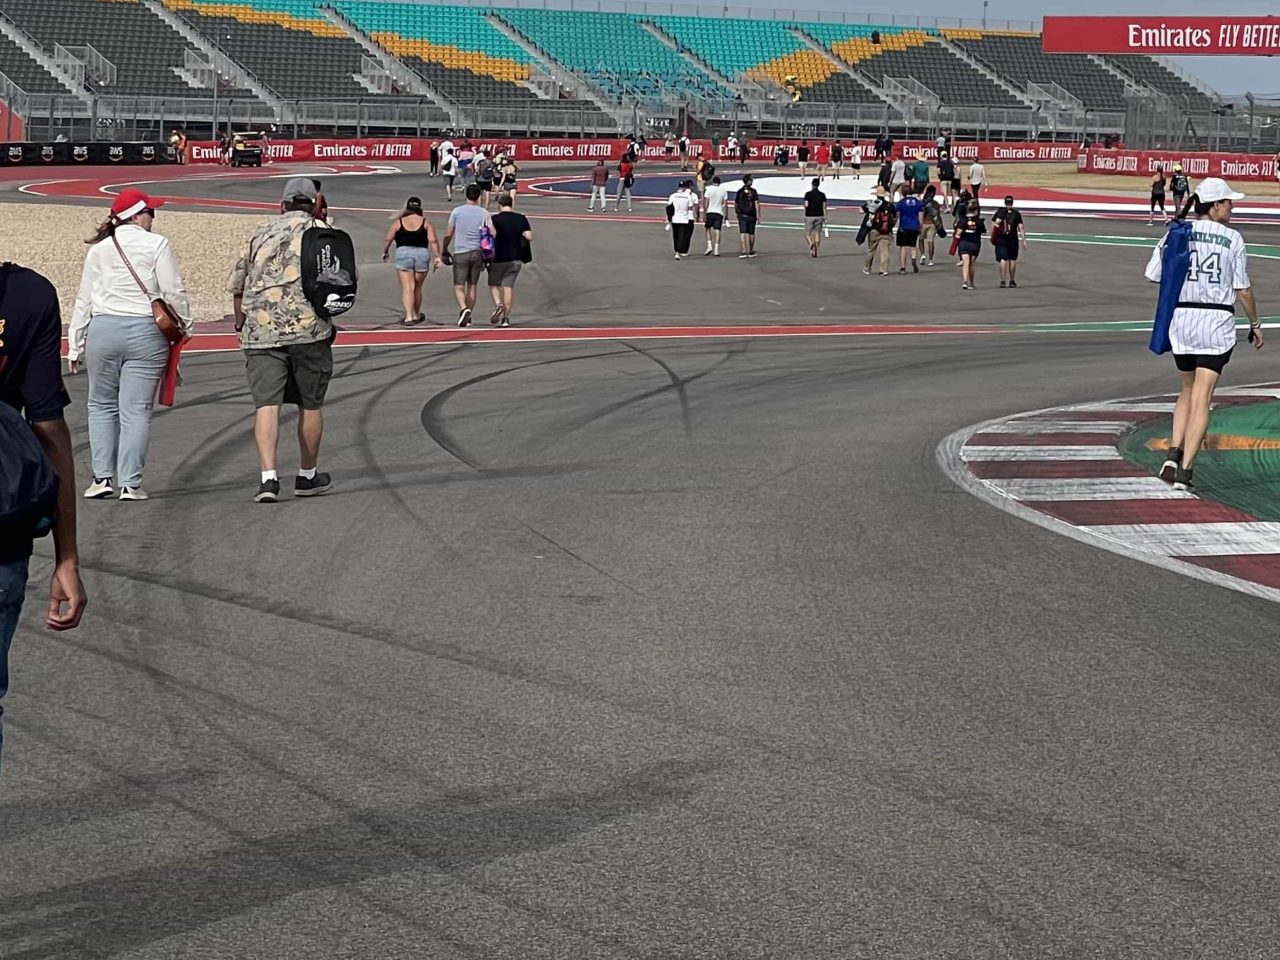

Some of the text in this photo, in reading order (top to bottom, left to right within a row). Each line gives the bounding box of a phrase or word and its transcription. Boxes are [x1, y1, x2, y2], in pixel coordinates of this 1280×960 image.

[1128, 23, 1211, 47] Emirates
[1218, 24, 1241, 48] FLY
[314, 144, 367, 157] Emirates
[385, 144, 412, 157] BETTER
[532, 144, 612, 157] Emirates FLY BETTER
[761, 145, 773, 157] FLY
[957, 146, 979, 158] BETTER
[994, 147, 1072, 159] Emirates FLY BETTER
[1190, 158, 1209, 174] BETTER
[1221, 160, 1259, 176] Emirates
[1261, 161, 1273, 176] FLY
